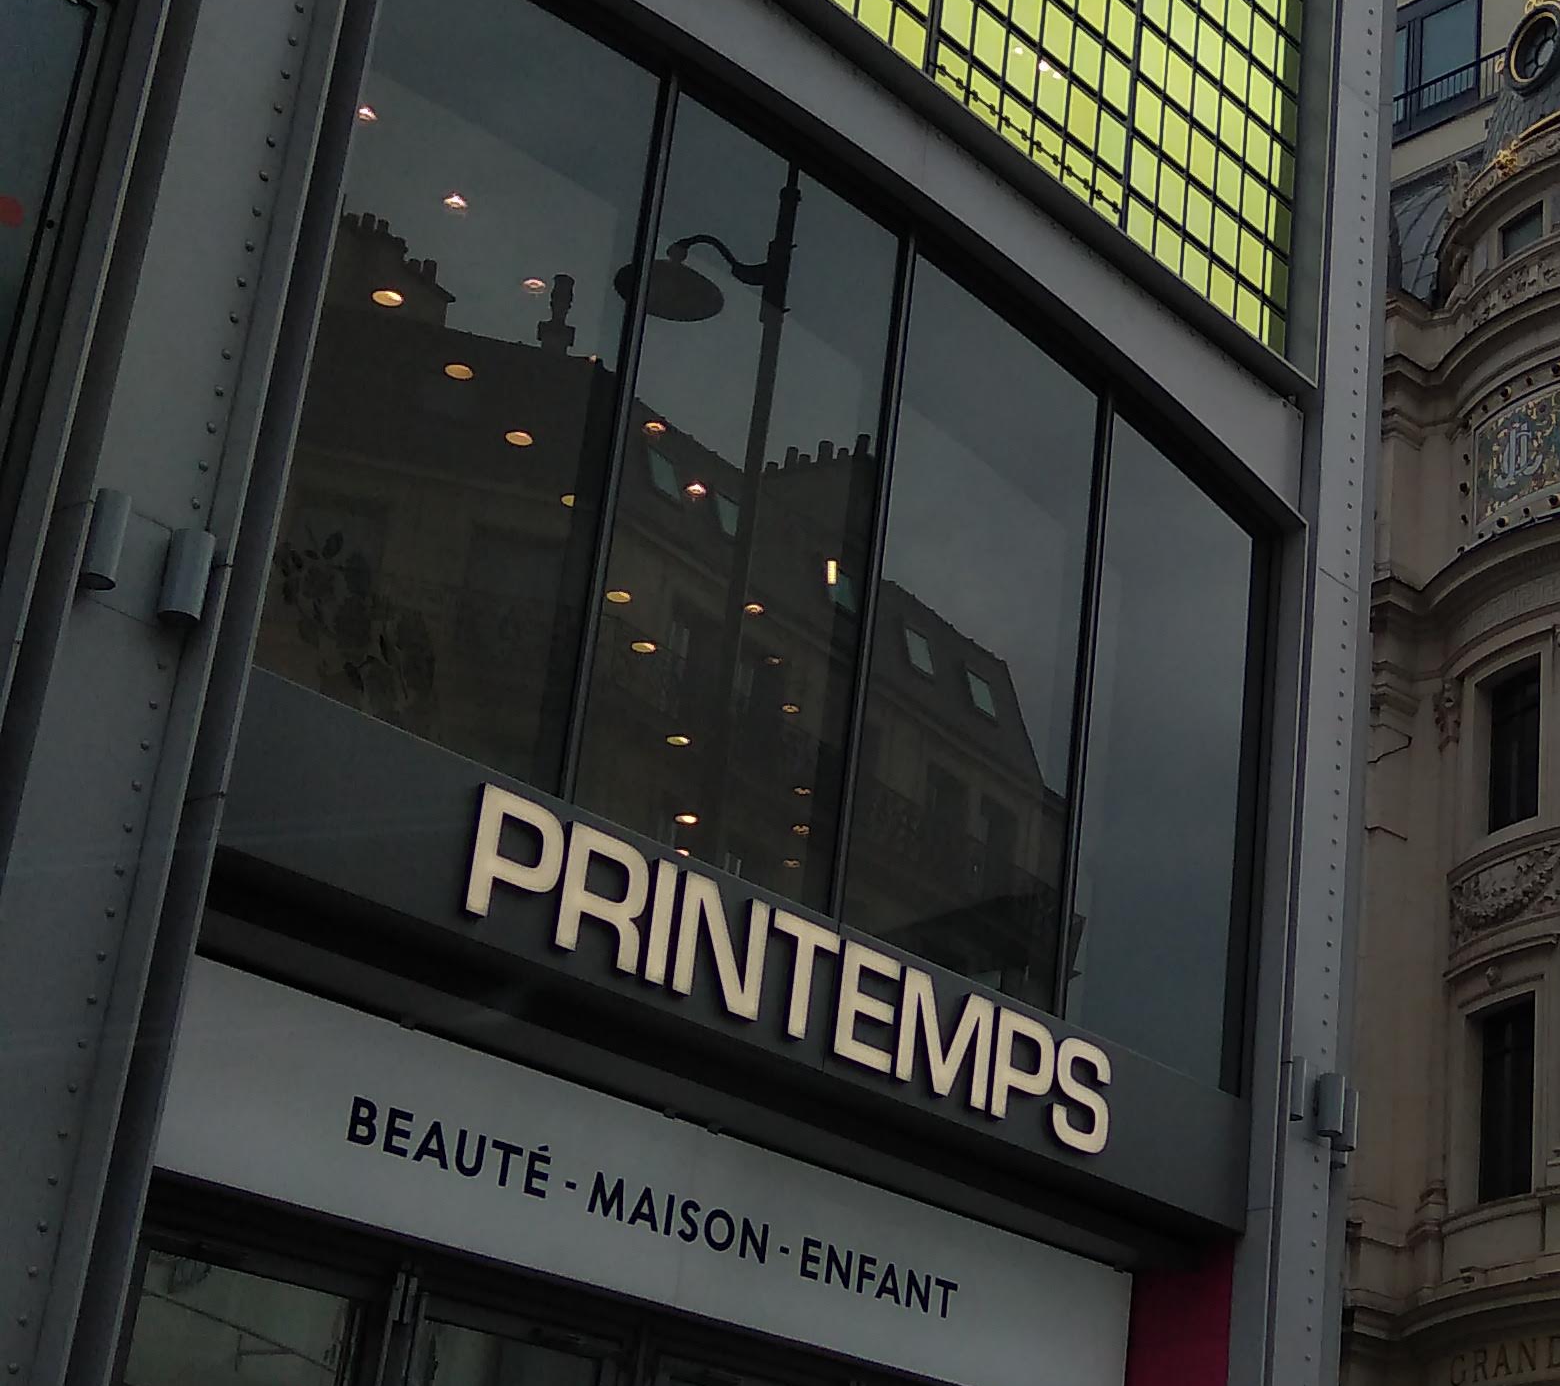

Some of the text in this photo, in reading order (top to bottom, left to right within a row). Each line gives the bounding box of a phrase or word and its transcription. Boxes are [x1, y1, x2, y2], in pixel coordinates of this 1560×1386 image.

[463, 781, 1114, 1155] PRINTEMPS
[346, 1094, 553, 1199] BEAUTÉ
[586, 1170, 770, 1265] MAISON
[799, 1237, 959, 1322] ENFANT
